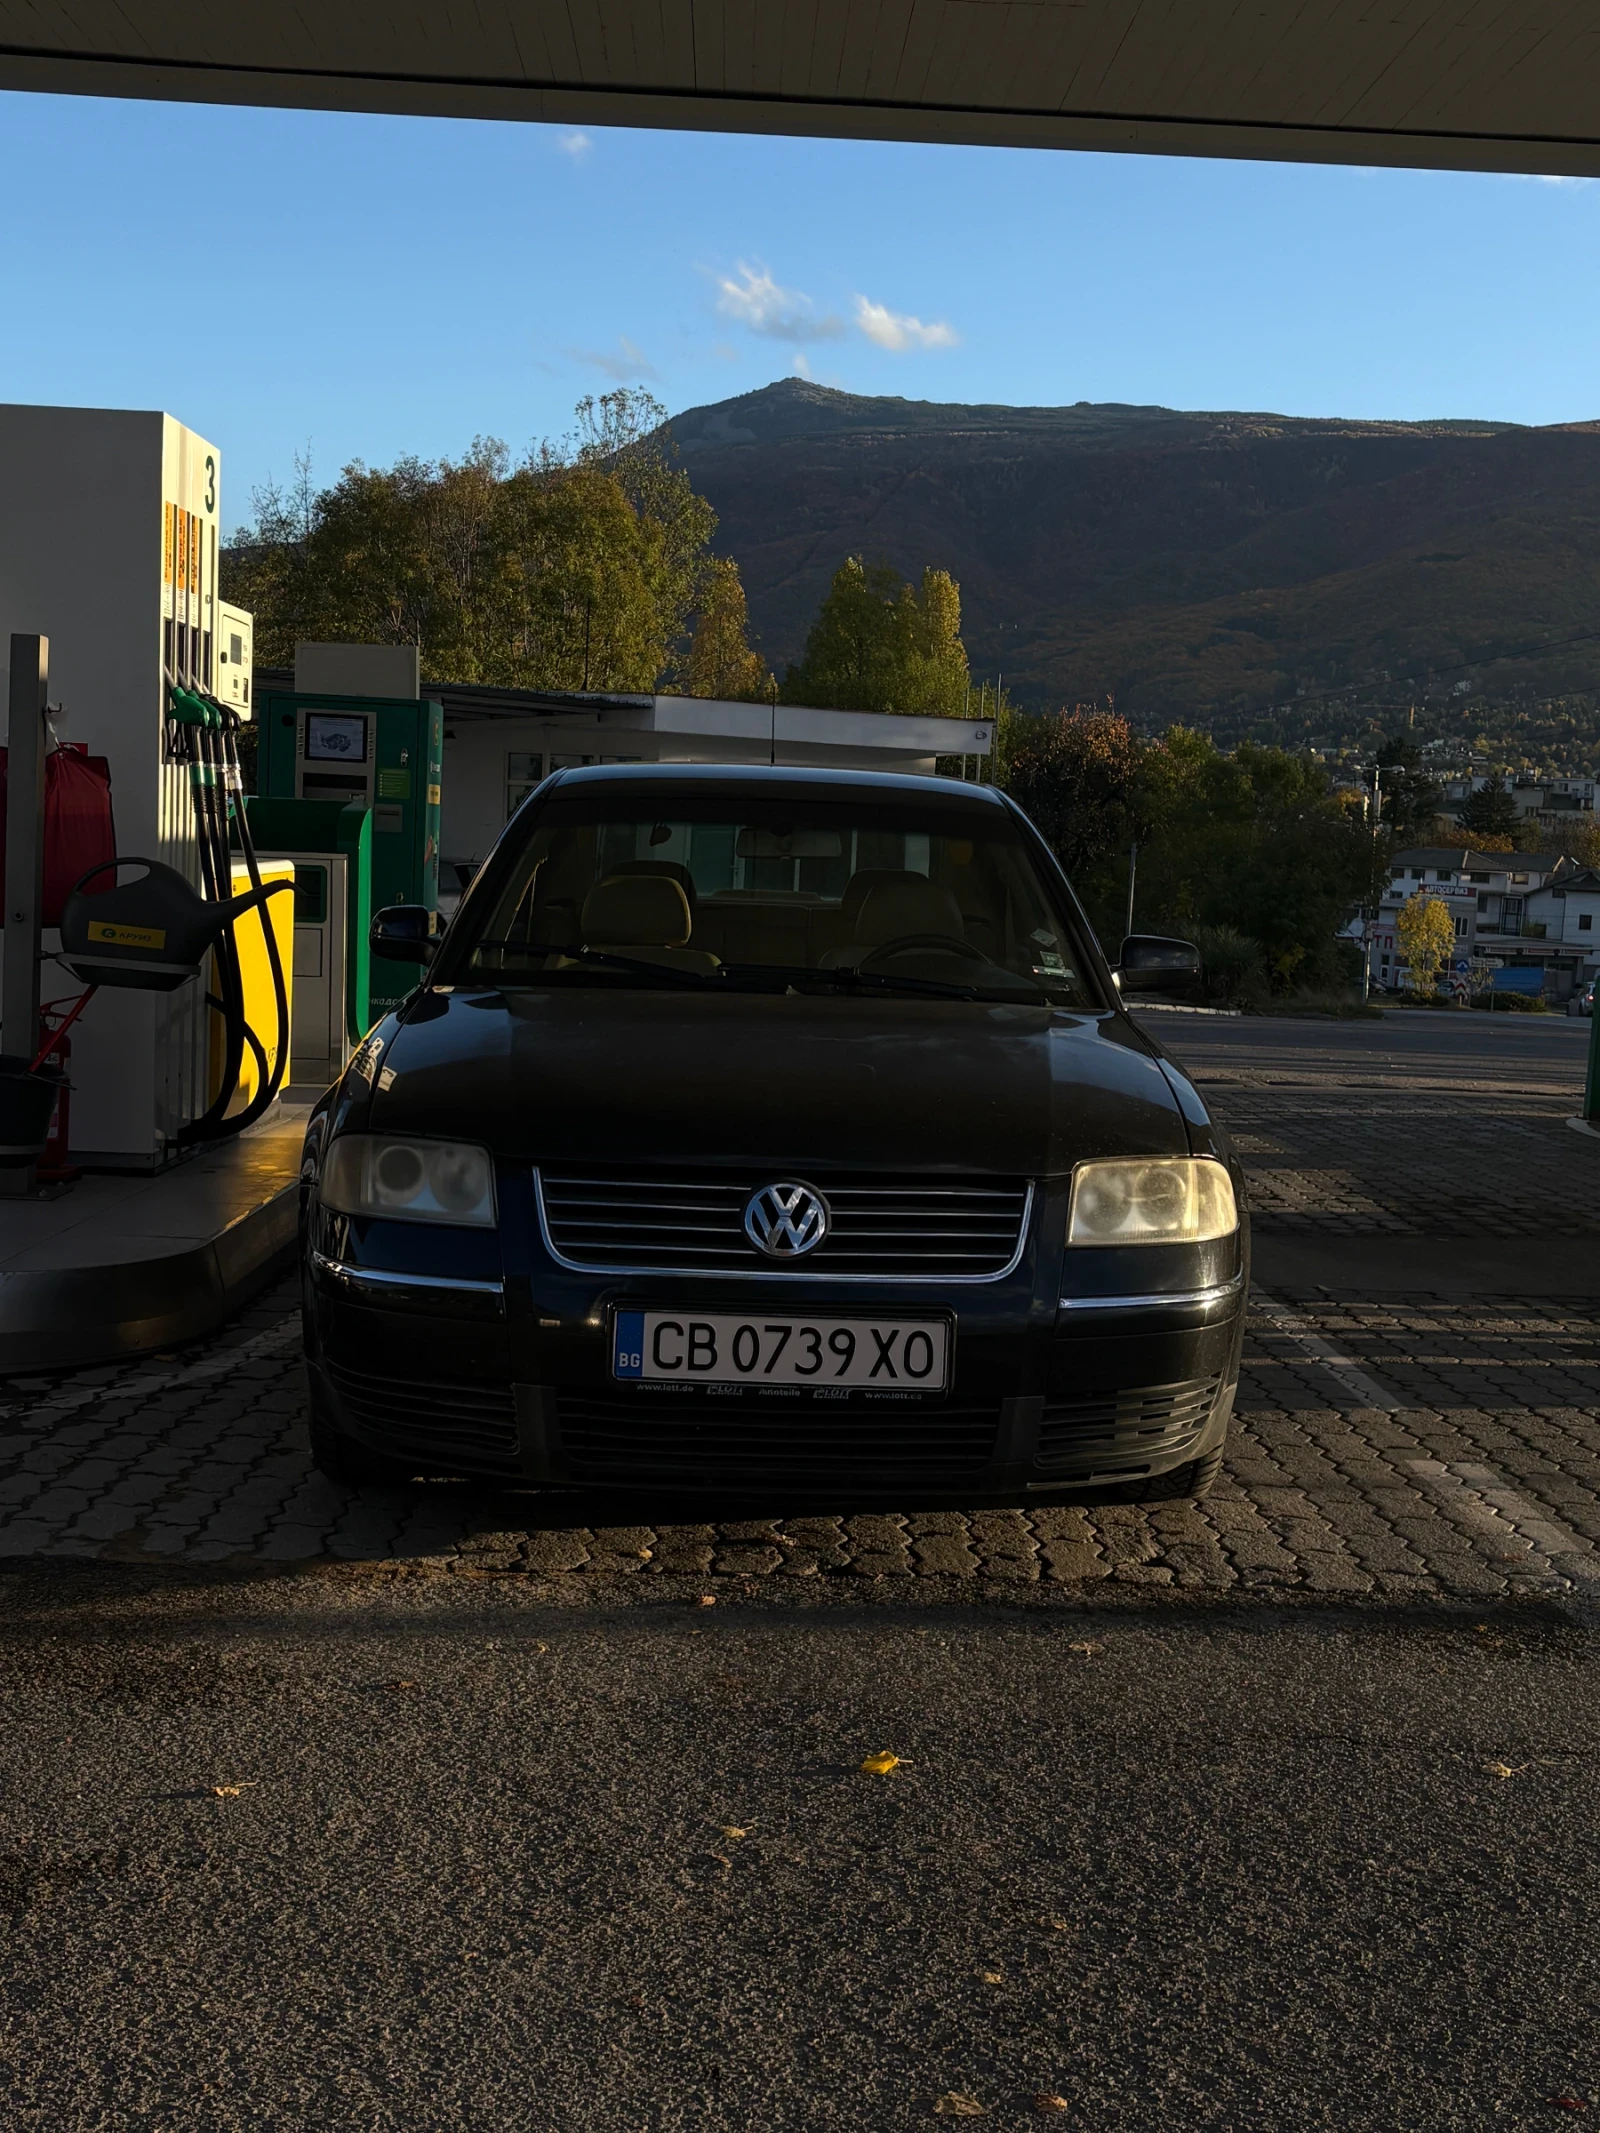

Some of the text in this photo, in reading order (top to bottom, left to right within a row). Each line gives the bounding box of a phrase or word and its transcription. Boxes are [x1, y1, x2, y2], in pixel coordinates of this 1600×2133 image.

[204, 455, 216, 514] 3
[119, 931, 152, 942] КРУИЗ
[619, 1352, 640, 1367] BG
[652, 1321, 934, 1378] CB 0739 XO
